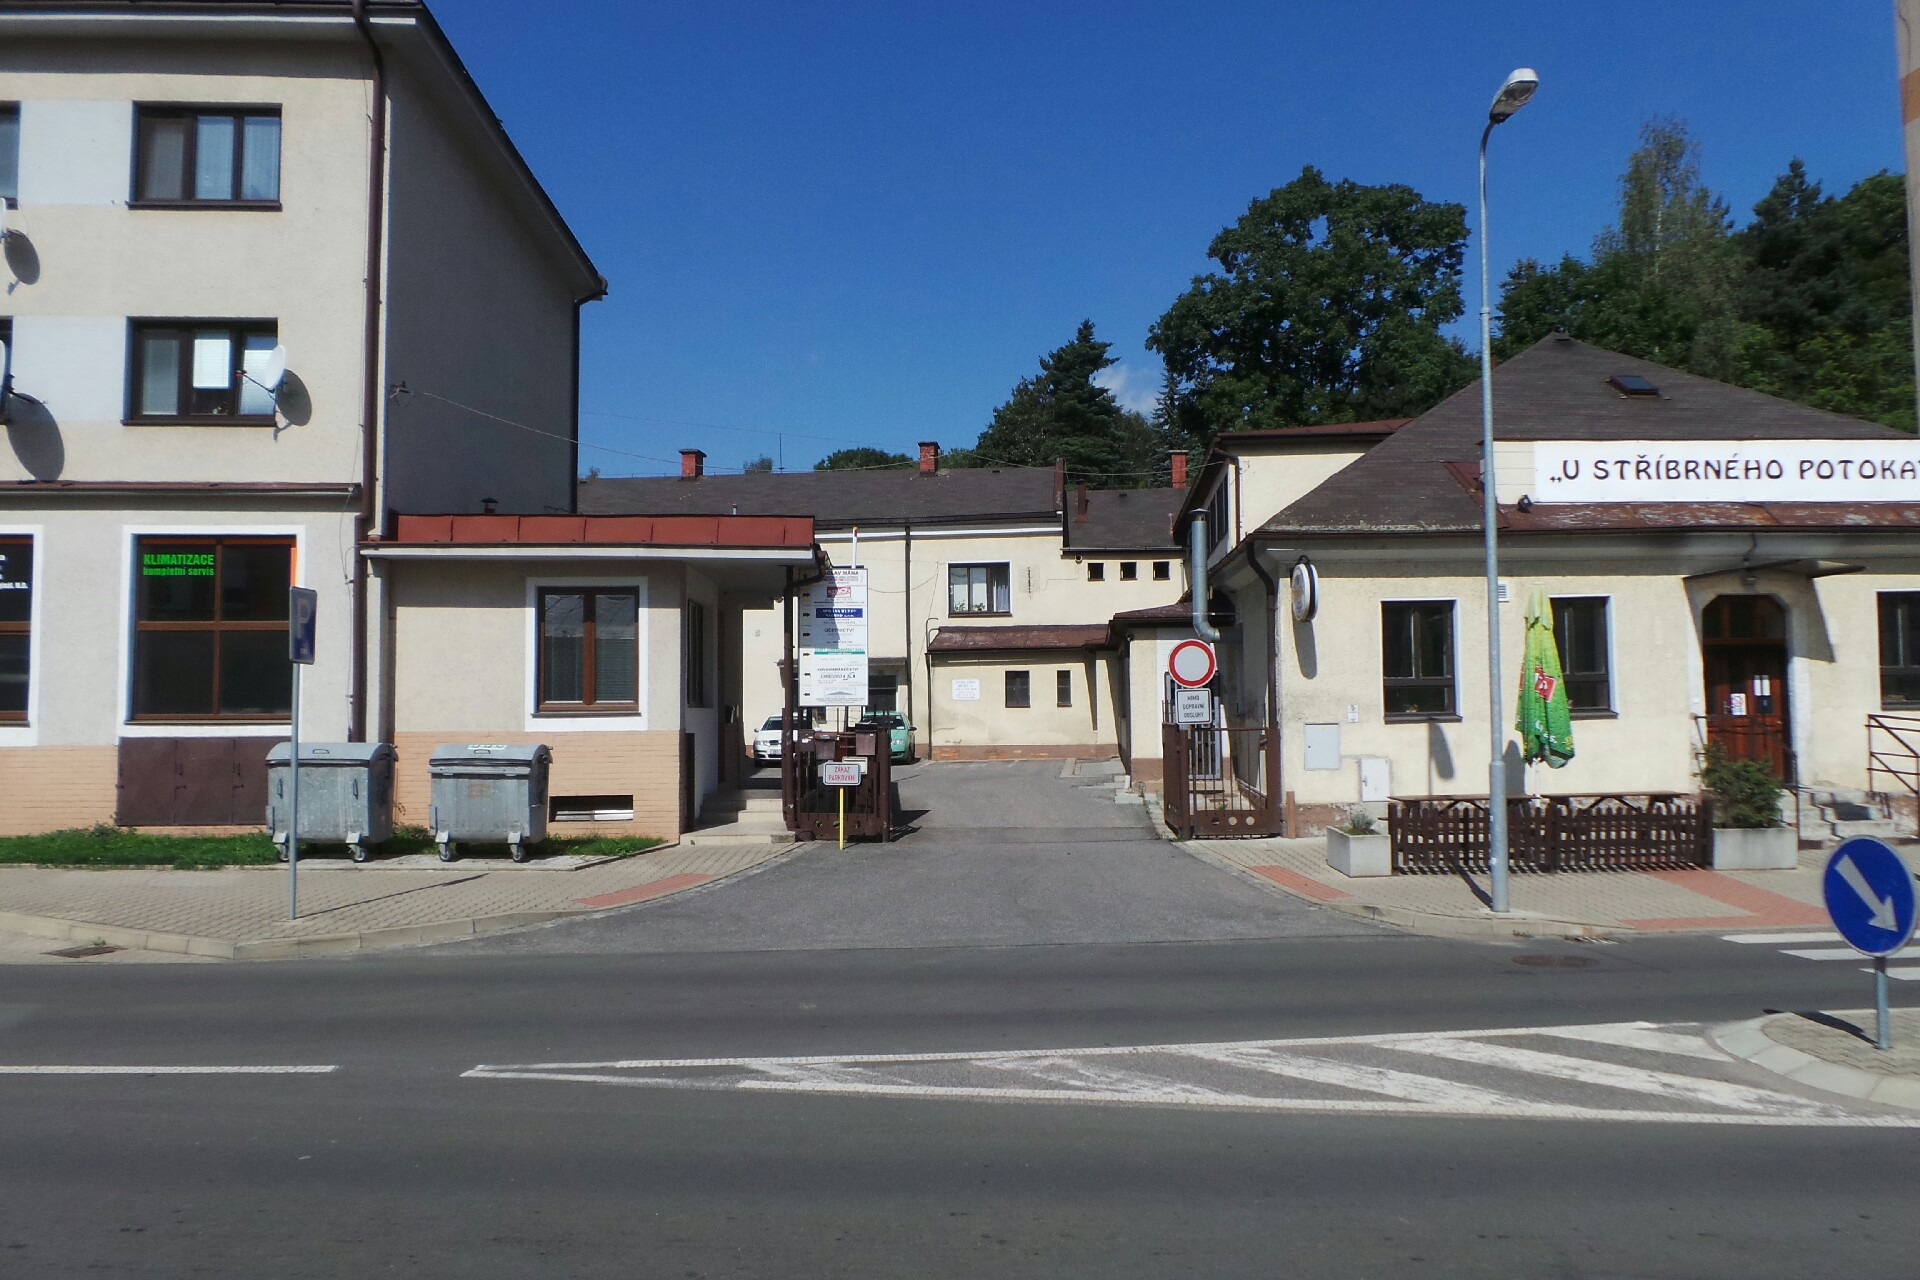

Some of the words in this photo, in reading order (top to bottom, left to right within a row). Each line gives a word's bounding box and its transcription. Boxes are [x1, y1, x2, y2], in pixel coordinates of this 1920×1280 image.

[1593, 453, 1783, 480] STŘÍBRNÉHO
[1800, 459, 1920, 480] POTOKA
[143, 554, 215, 565] KLIMATIZACE
[143, 567, 186, 576] kompletní
[187, 567, 215, 576] servis
[296, 597, 311, 639] P
